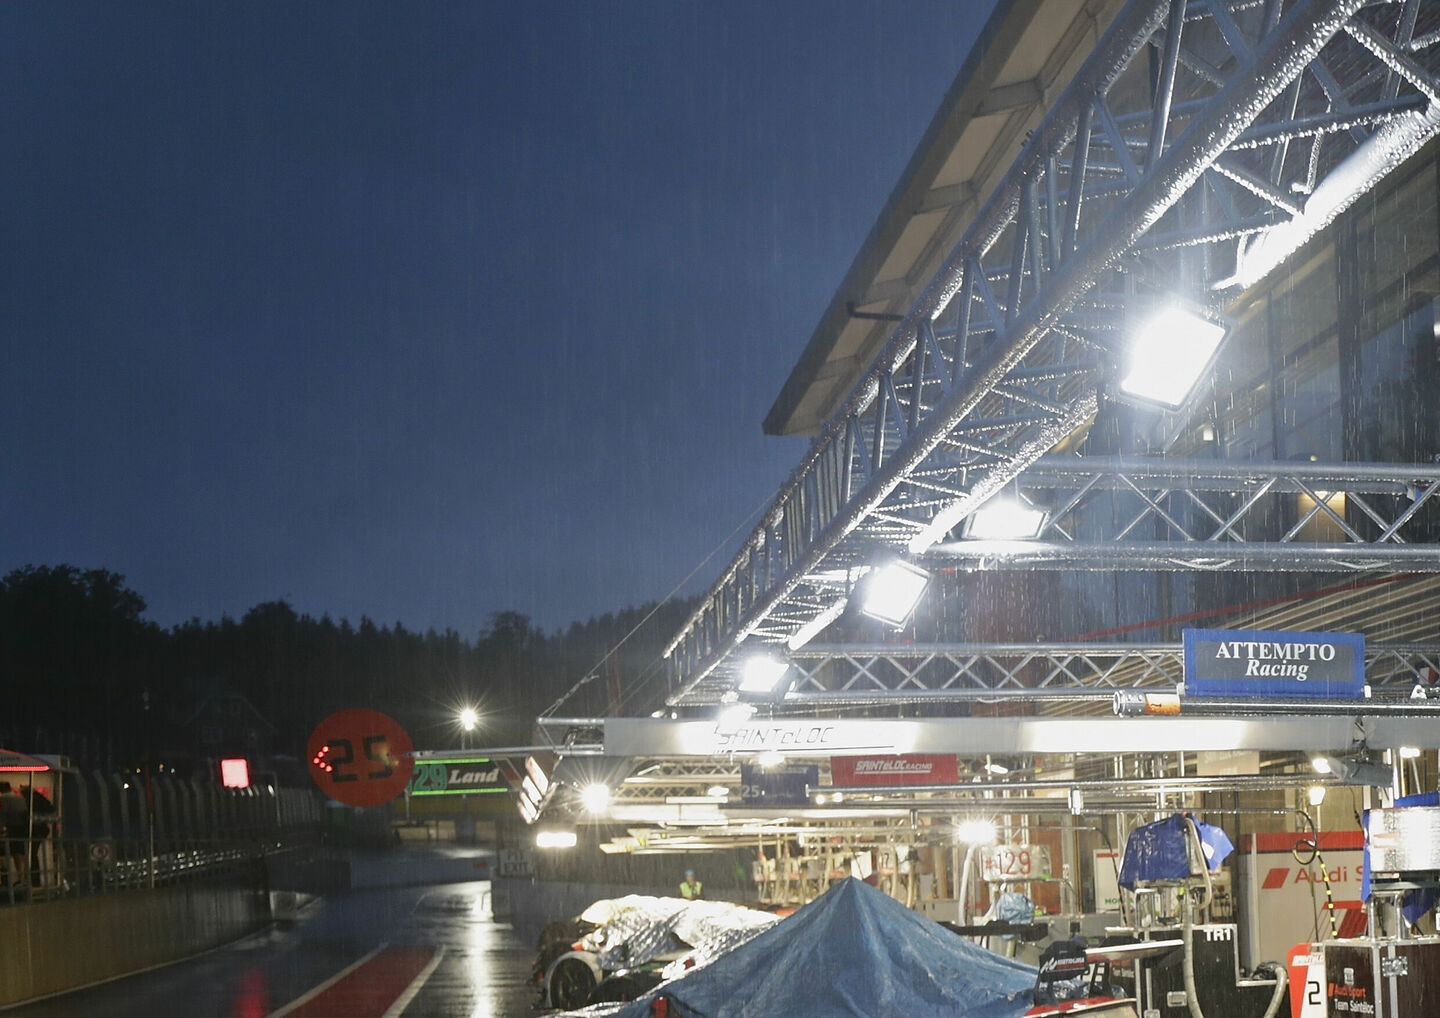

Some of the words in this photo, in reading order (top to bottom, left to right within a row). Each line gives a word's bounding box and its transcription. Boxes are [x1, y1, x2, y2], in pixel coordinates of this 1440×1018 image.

[1215, 641, 1336, 661] ATTEMPTO
[1245, 659, 1309, 681] Racing
[328, 736, 393, 783] 25
[408, 764, 448, 792] 29
[449, 767, 500, 784] Land
[1294, 867, 1347, 884] Audi
[1203, 928, 1232, 941] TR1
[1308, 981, 1321, 1005] 2
